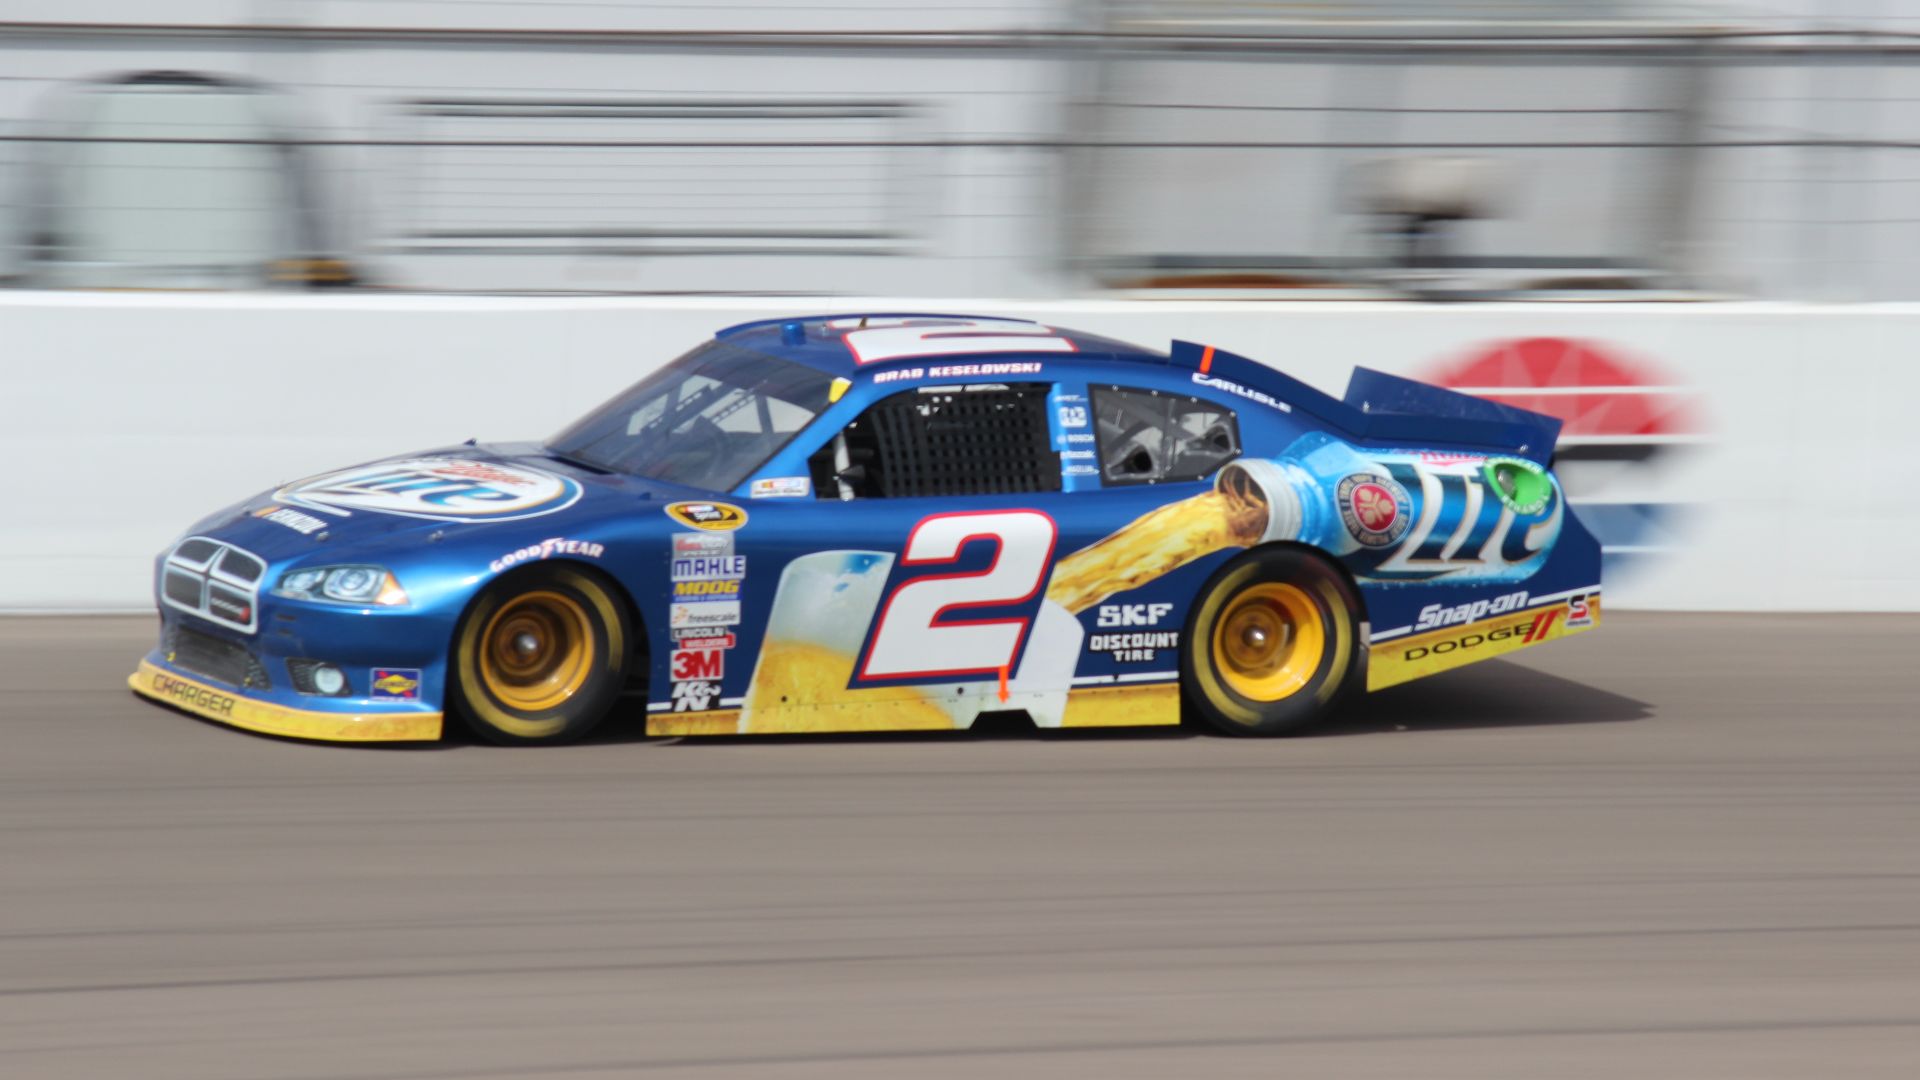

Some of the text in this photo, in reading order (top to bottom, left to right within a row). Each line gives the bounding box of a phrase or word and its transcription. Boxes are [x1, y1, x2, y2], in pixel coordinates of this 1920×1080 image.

[873, 362, 1042, 384] BRAD KESELOWSKI
[1192, 372, 1292, 413] CARLISLE
[489, 537, 604, 573] GOODYEAR
[674, 558, 744, 577] MAHLE
[673, 581, 740, 596] MOOG
[858, 508, 1058, 681] 2
[1097, 603, 1173, 627] SKF
[1414, 590, 1529, 631] Snap-on
[674, 627, 725, 639] LINCOLN
[1090, 631, 1179, 651] DISCOUNT
[1404, 621, 1536, 662] DODGE
[673, 649, 721, 679] 3M
[1113, 649, 1155, 662] TIRE
[153, 673, 235, 717] CHARGER
